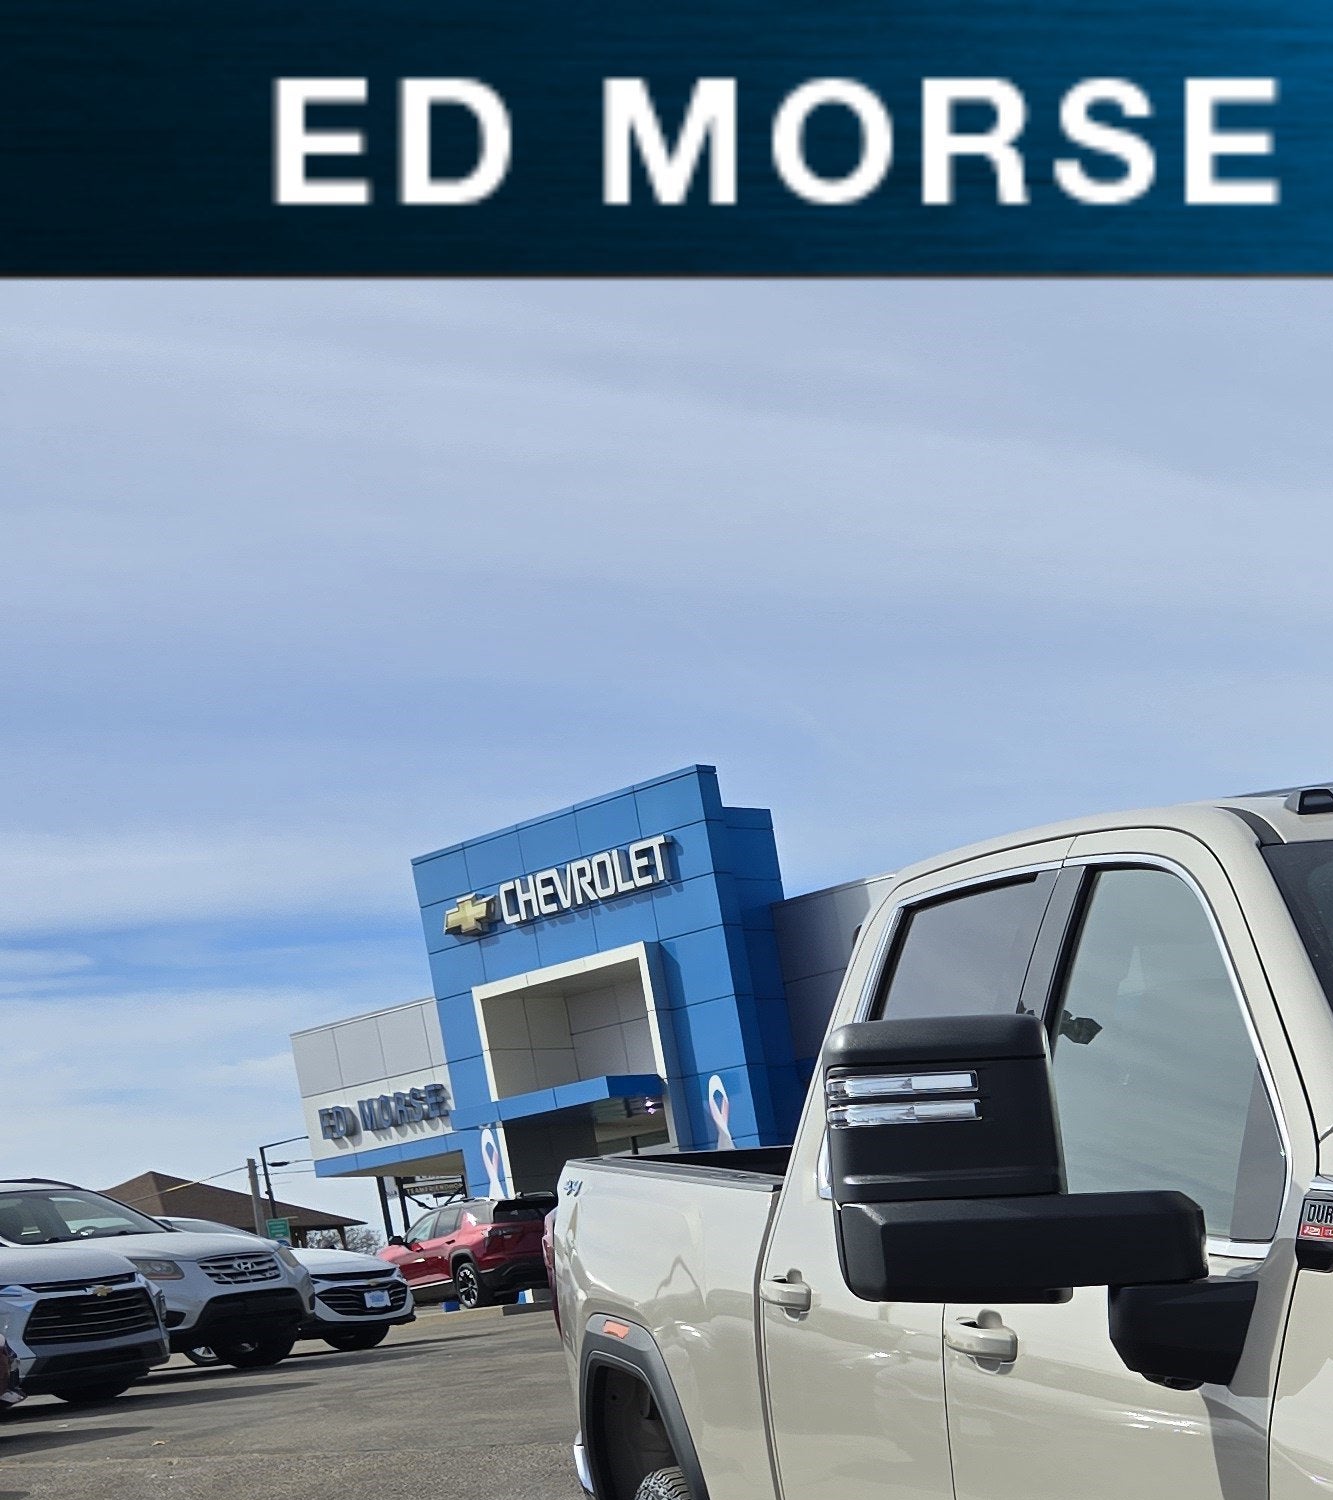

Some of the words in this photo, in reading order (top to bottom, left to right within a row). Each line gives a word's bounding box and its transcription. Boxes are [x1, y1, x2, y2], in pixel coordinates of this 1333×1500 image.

[499, 834, 669, 925] CHEVROLET
[318, 1105, 354, 1139] ED
[357, 1083, 450, 1131] MORSE
